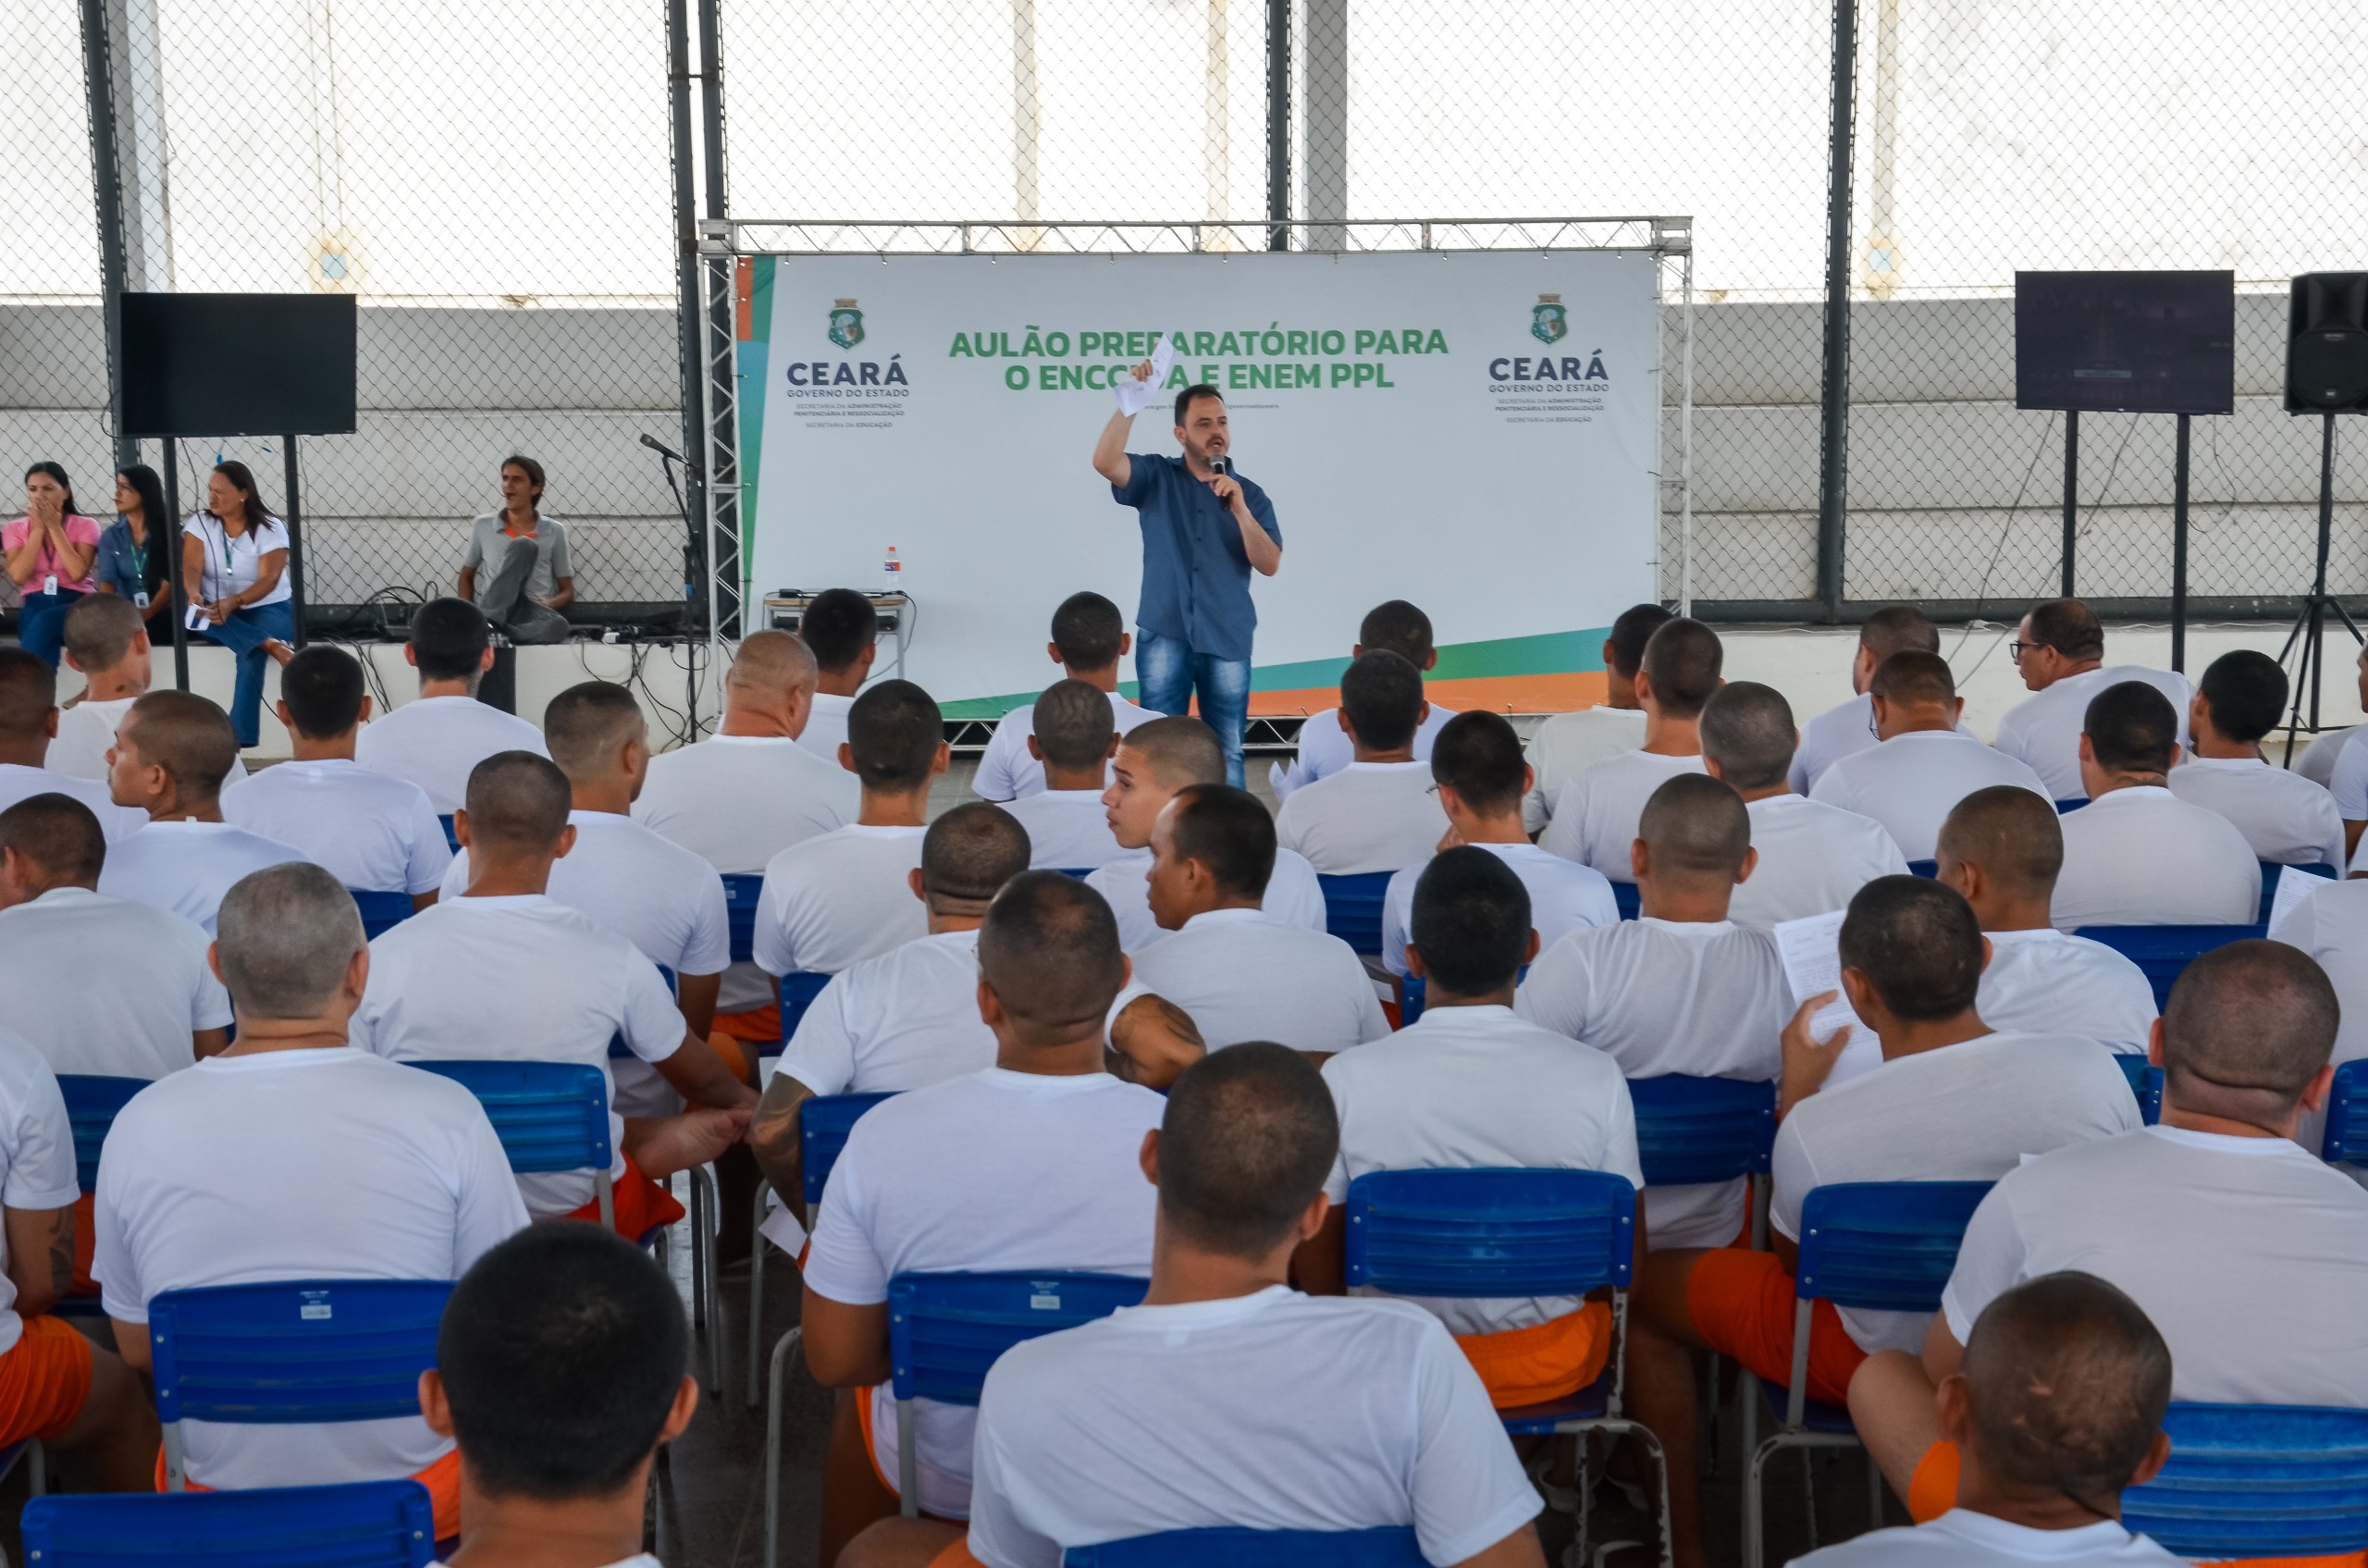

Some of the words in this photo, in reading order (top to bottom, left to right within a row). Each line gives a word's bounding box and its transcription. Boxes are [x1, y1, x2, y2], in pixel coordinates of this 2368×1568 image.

[948, 324, 1071, 358] AULÃO
[1079, 321, 1346, 358] PREPARATÓRIO
[1354, 328, 1449, 355] PARA
[786, 352, 909, 387] CEARÁ
[1005, 364, 1030, 391] O
[1039, 364, 1191, 390] ENCCA
[1201, 364, 1220, 389] E
[1228, 363, 1322, 389] ENEM
[1330, 362, 1395, 389] PPL
[1488, 348, 1610, 381] CEARÁ
[786, 389, 843, 398] GOVERNO
[845, 389, 863, 398] DO
[866, 389, 909, 398] ESTADO
[1488, 384, 1544, 393] GOVERNO
[1547, 384, 1563, 392] DO
[1566, 383, 1610, 392] ESTADO
